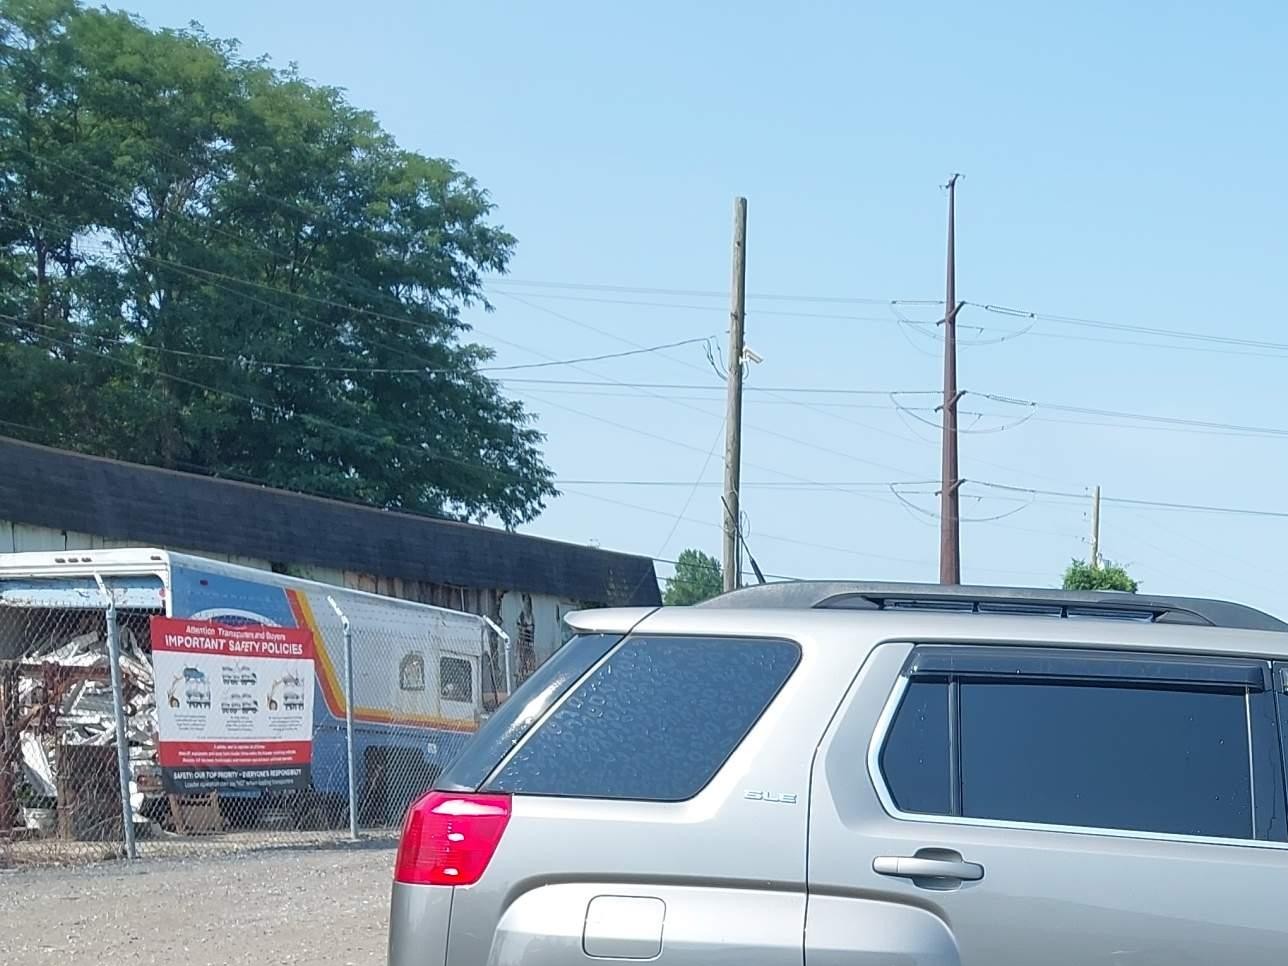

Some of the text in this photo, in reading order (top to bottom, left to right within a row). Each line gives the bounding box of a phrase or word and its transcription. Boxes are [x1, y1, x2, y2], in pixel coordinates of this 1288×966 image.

[186, 625, 215, 636] Attention
[165, 634, 303, 655] IMPORTANT SAFETY POLICIES
[743, 790, 798, 804] SLE
